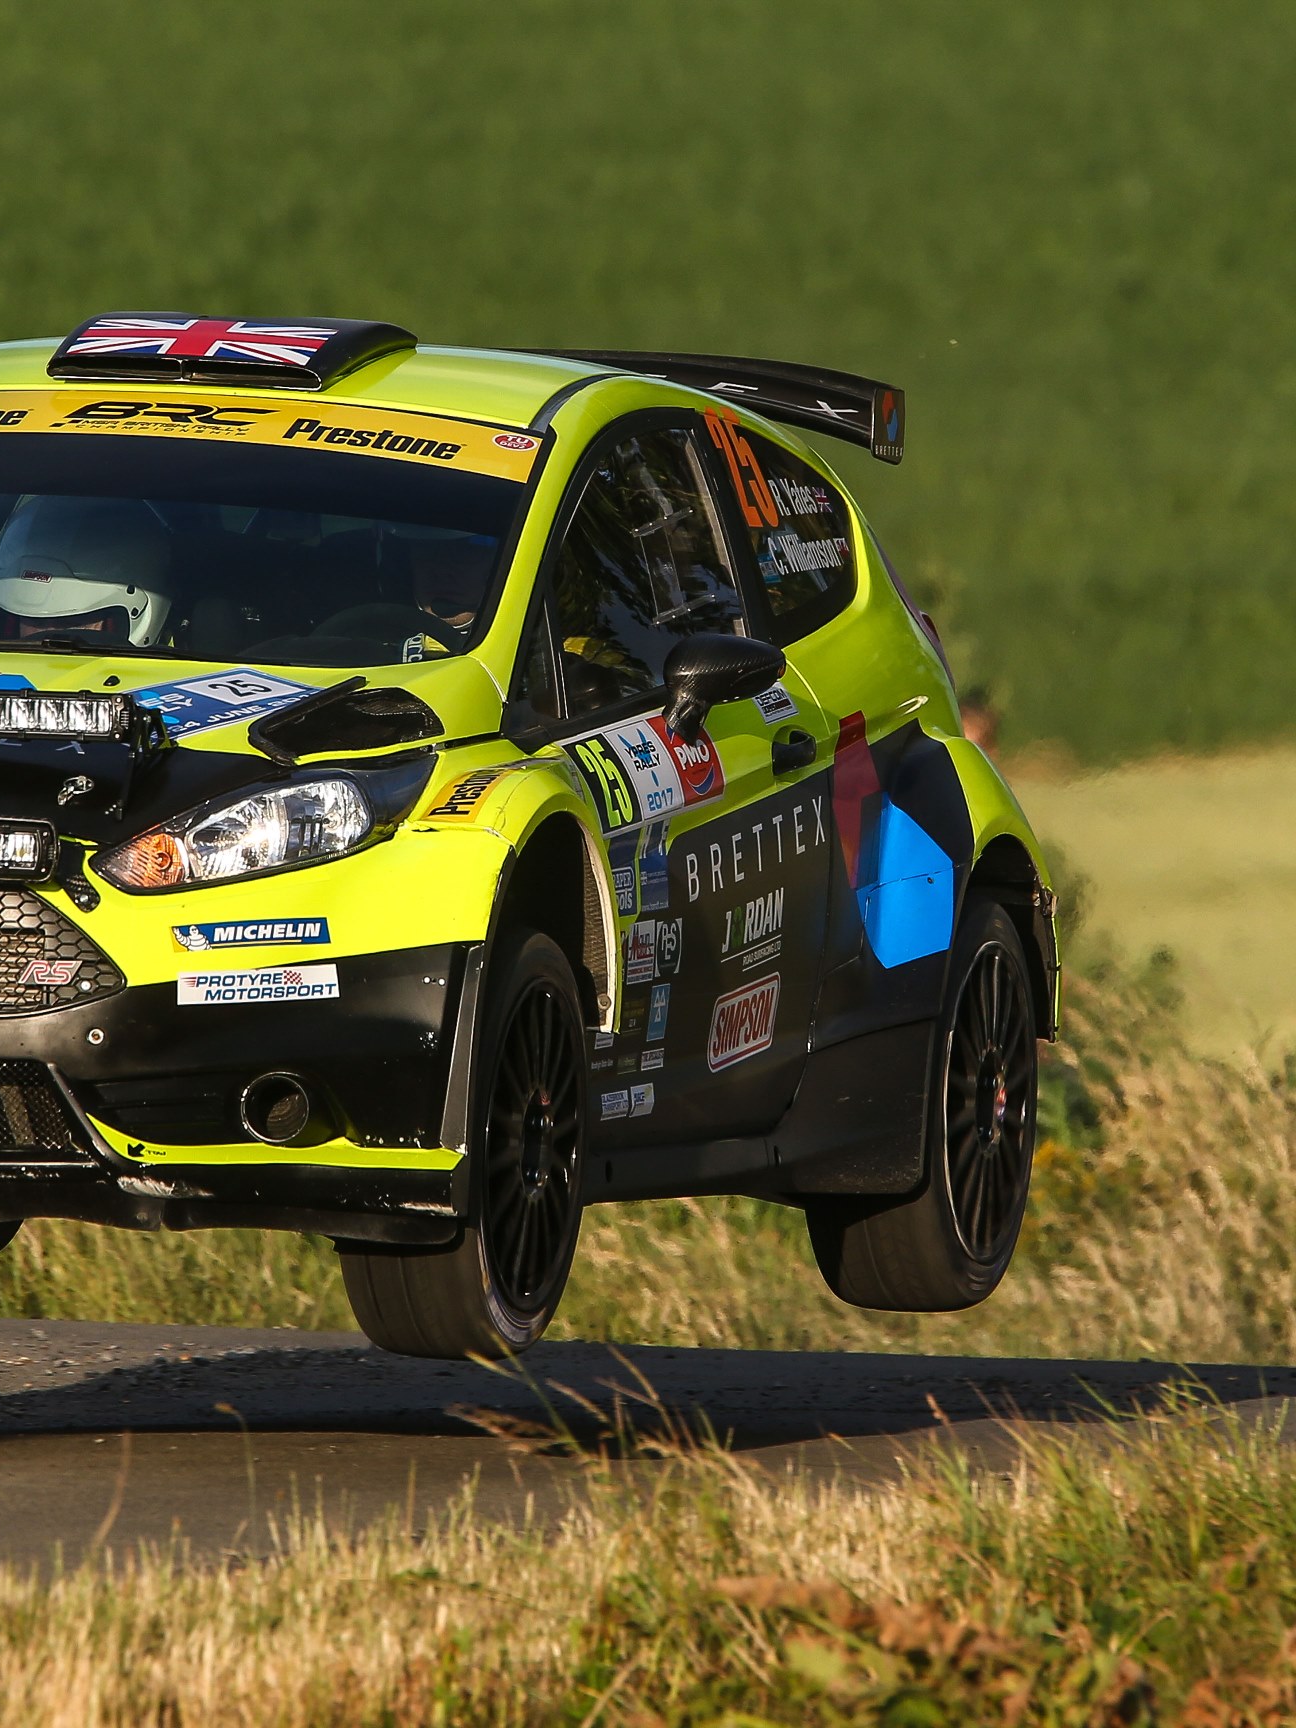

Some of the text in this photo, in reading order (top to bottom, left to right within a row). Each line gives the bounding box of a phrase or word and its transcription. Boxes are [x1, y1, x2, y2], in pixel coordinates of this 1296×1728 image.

[63, 401, 281, 426] BRC
[75, 424, 247, 436] CHAMPIONSHIP
[125, 421, 189, 429] BRITISH
[191, 424, 251, 432] RALLY
[282, 418, 462, 460] Prestone
[704, 406, 779, 528] 25
[768, 478, 818, 517] R. Yates
[767, 537, 789, 575] C.
[778, 533, 841, 573] Williamson
[208, 679, 273, 697] 25
[207, 705, 267, 724] JUNE
[624, 741, 657, 759] YPRES
[673, 739, 710, 771] PMO
[633, 753, 661, 772] RALLY
[575, 739, 634, 828] 25
[647, 788, 675, 812] 2017
[686, 795, 826, 903] BRETTEX
[213, 922, 321, 943] MICHELIN
[195, 972, 284, 988] PROTYRE
[204, 983, 337, 1001] MOTORSPORT
[712, 987, 775, 1058] SIMPSON
